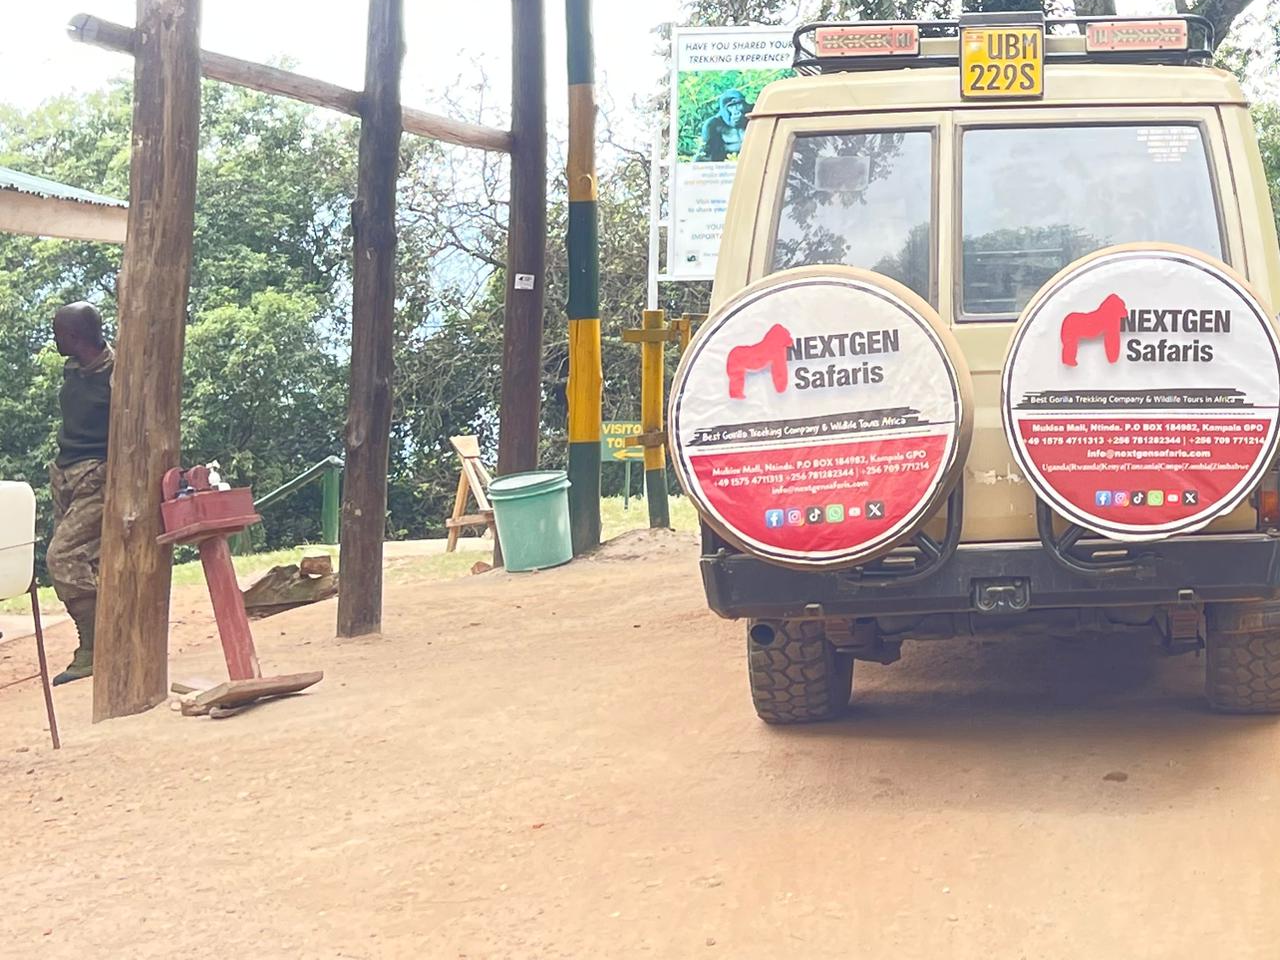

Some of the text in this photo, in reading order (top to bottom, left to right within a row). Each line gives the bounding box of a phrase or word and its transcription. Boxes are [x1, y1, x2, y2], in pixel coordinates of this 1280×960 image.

[685, 41, 794, 51] HAVE YOU SHARED YOUR
[987, 33, 1038, 60] UBM
[689, 53, 790, 64] TREKKING EXPERIENCE?
[970, 63, 1035, 90] 229S
[1120, 309, 1231, 334] NEXTGEN
[786, 329, 900, 361] NEXTGEN
[1126, 339, 1213, 362] Safaris
[794, 361, 884, 390] Safaris
[1075, 395, 1107, 404] Trekking
[1109, 395, 1144, 405] Company
[1154, 395, 1181, 403] Wildlife
[1205, 395, 1213, 403] in
[1214, 395, 1236, 403] Africa
[602, 423, 642, 435] VISITO
[702, 432, 721, 442] Best
[722, 430, 748, 439] Gorilla
[749, 427, 783, 438] Trekking
[784, 425, 820, 436] Company
[830, 421, 857, 431] Wildlife
[858, 419, 879, 429] Tours
[881, 416, 907, 426] Africa
[1032, 423, 1065, 432] Mukisa
[1067, 423, 1088, 433] Mall,
[1090, 423, 1123, 432] Ntinda.
[1125, 423, 1141, 432] P.O
[1143, 423, 1163, 432] BOX
[1202, 423, 1241, 433] Kampala
[1243, 423, 1264, 432] GPO
[1042, 436, 1064, 445] 1575
[1065, 436, 1105, 445] 4711313
[1233, 436, 1265, 445] 771214
[796, 460, 812, 469] P.O
[813, 458, 833, 467] BOX
[906, 449, 927, 460] GPO
[714, 478, 730, 487] +49
[731, 476, 750, 486] 1575
[752, 474, 784, 484] 4711313
[786, 471, 807, 481] +256
[862, 464, 882, 475] +256
[883, 463, 900, 473] 709
[901, 461, 930, 472] 771214
